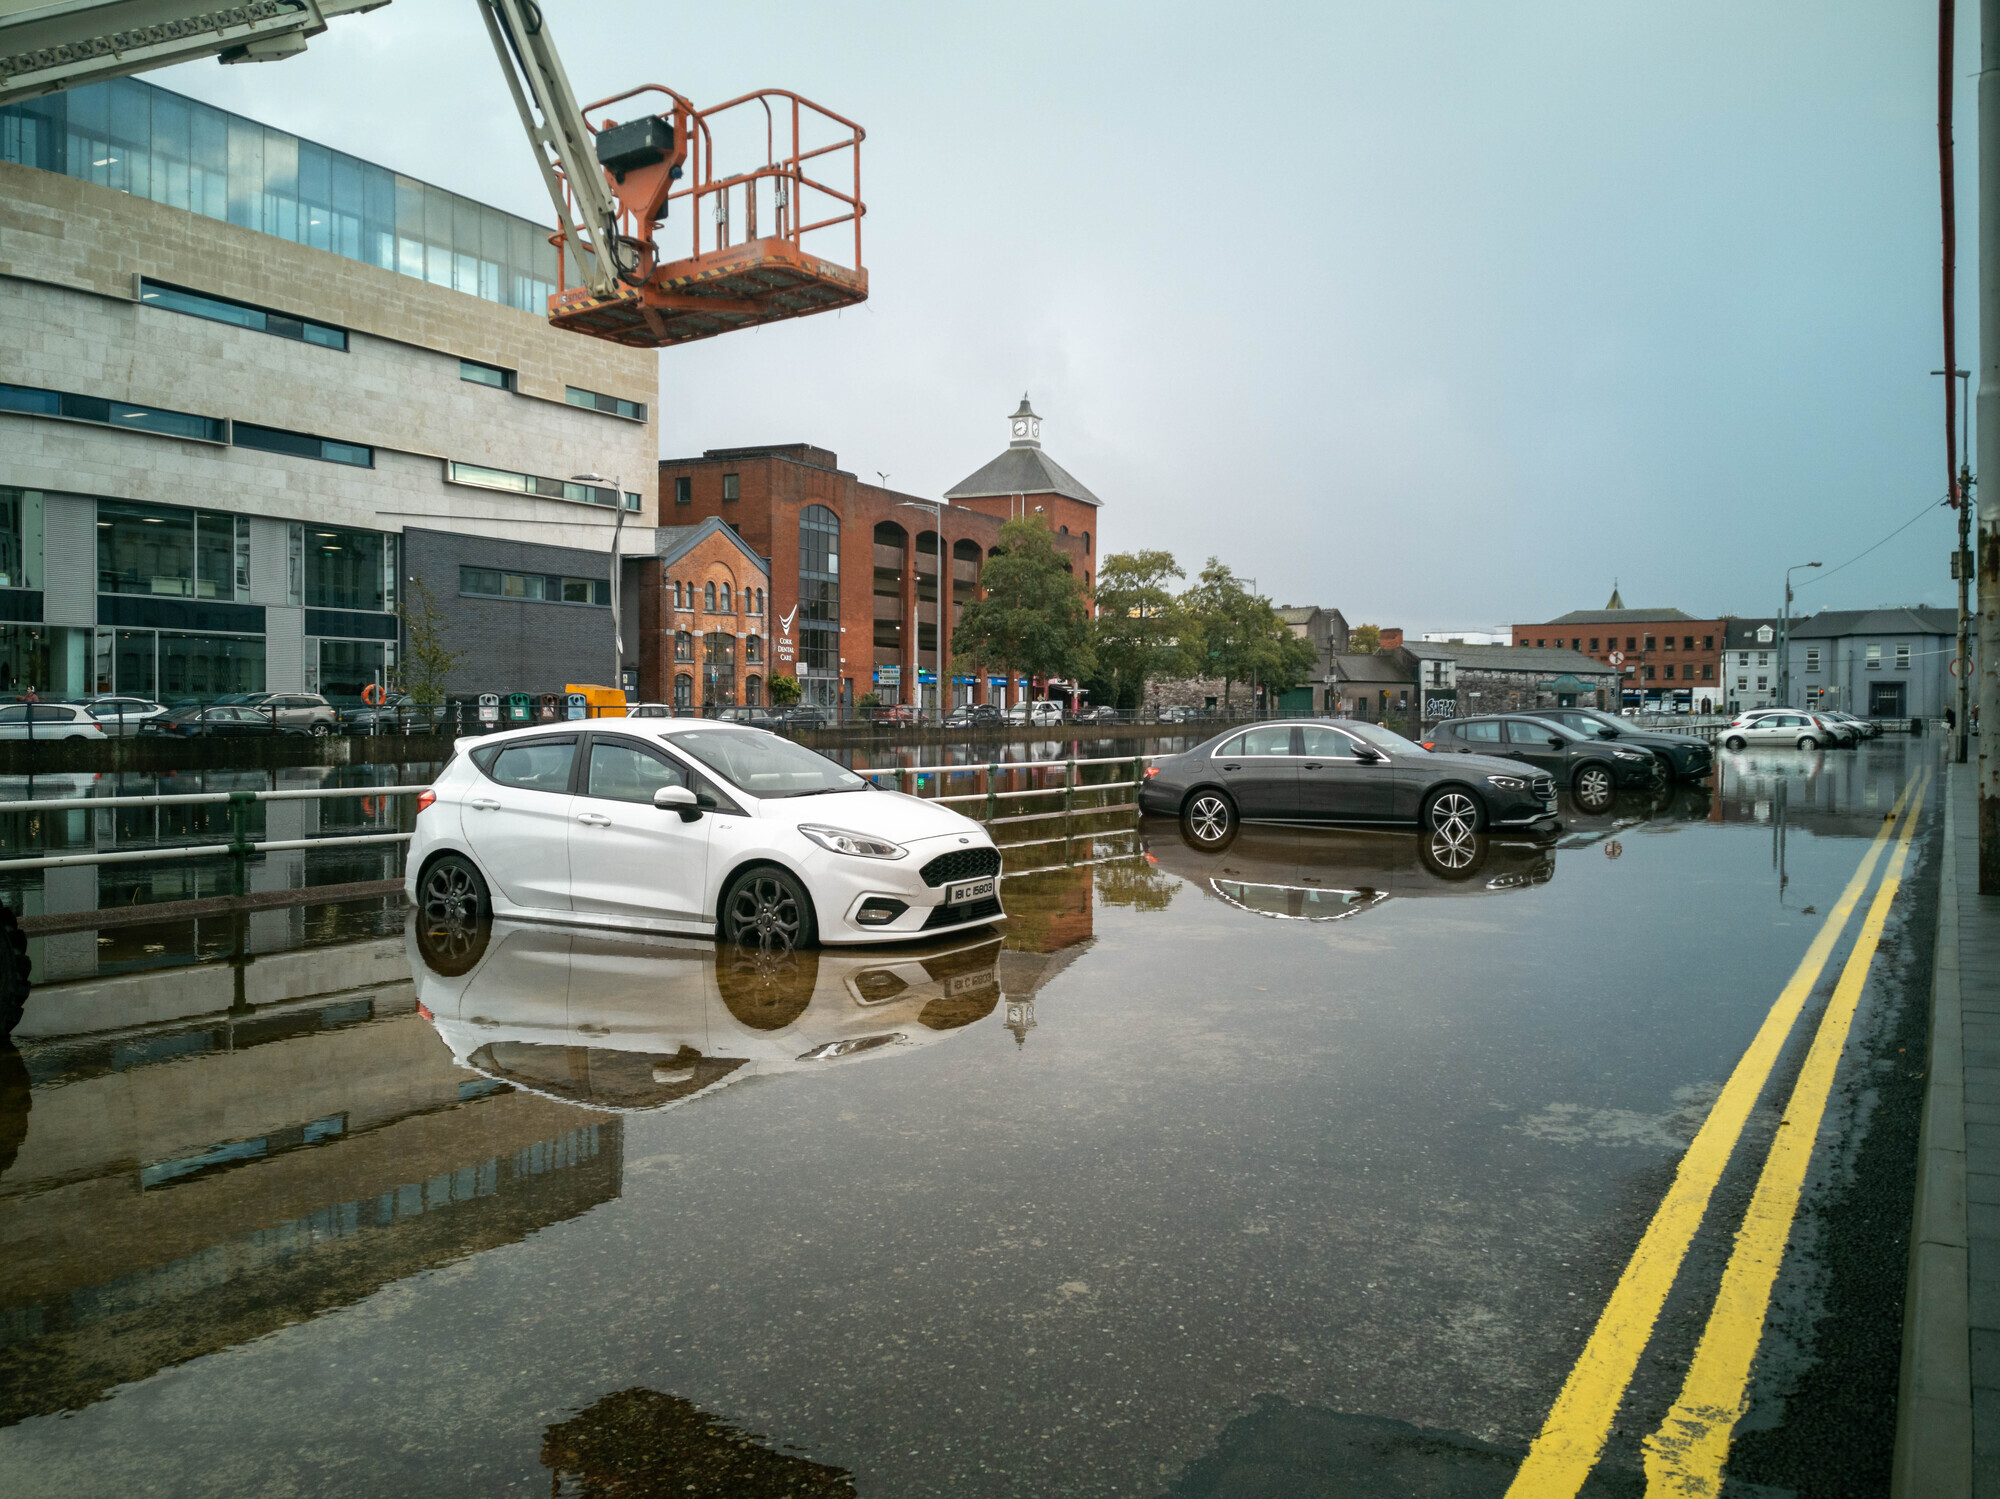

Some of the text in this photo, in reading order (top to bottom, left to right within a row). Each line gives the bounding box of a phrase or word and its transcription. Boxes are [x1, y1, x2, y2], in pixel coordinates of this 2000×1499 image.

[955, 883, 992, 899] 181 C 15803
